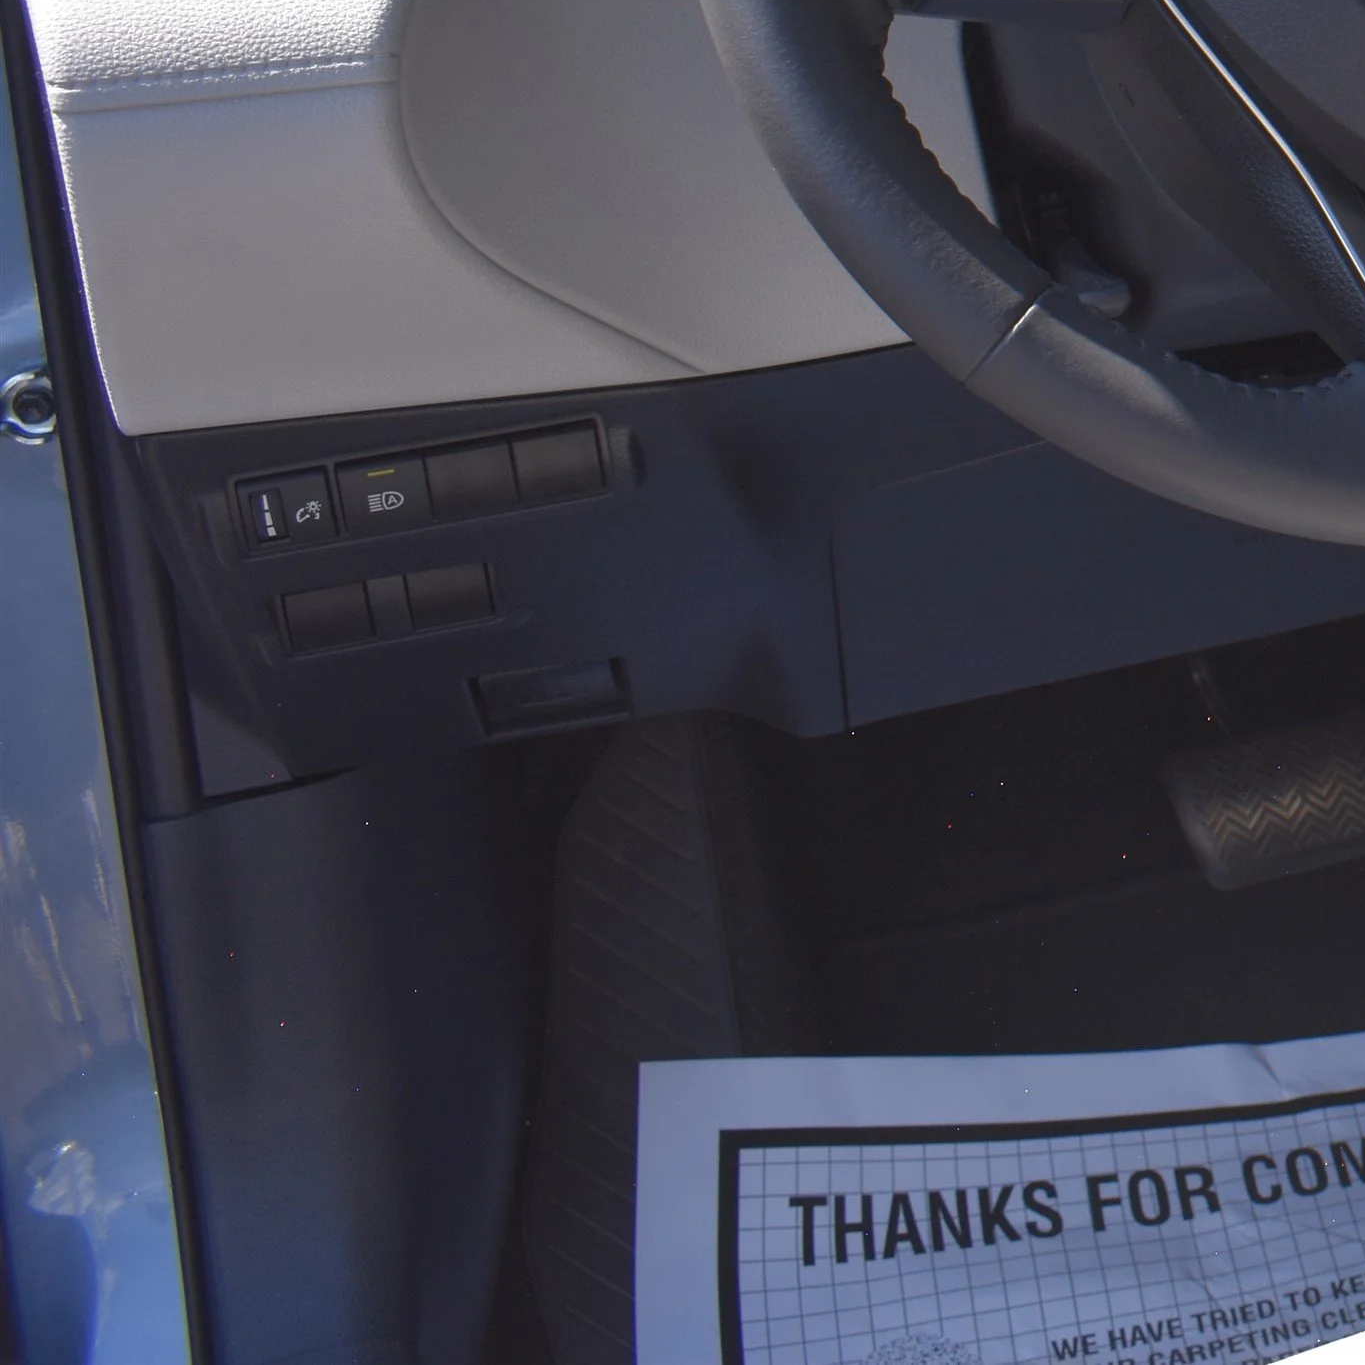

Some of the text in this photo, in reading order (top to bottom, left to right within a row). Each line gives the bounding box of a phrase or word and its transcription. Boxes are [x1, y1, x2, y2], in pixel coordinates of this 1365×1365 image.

[788, 1177, 1065, 1267] THANKS
[1085, 1164, 1223, 1234] FOR
[1051, 1333, 1099, 1361] WE
[1107, 1316, 1185, 1351] HAVE
[1190, 1297, 1277, 1334] TRIED
[1284, 1285, 1322, 1312] TO
[1148, 1318, 1312, 1365] CARPETING
